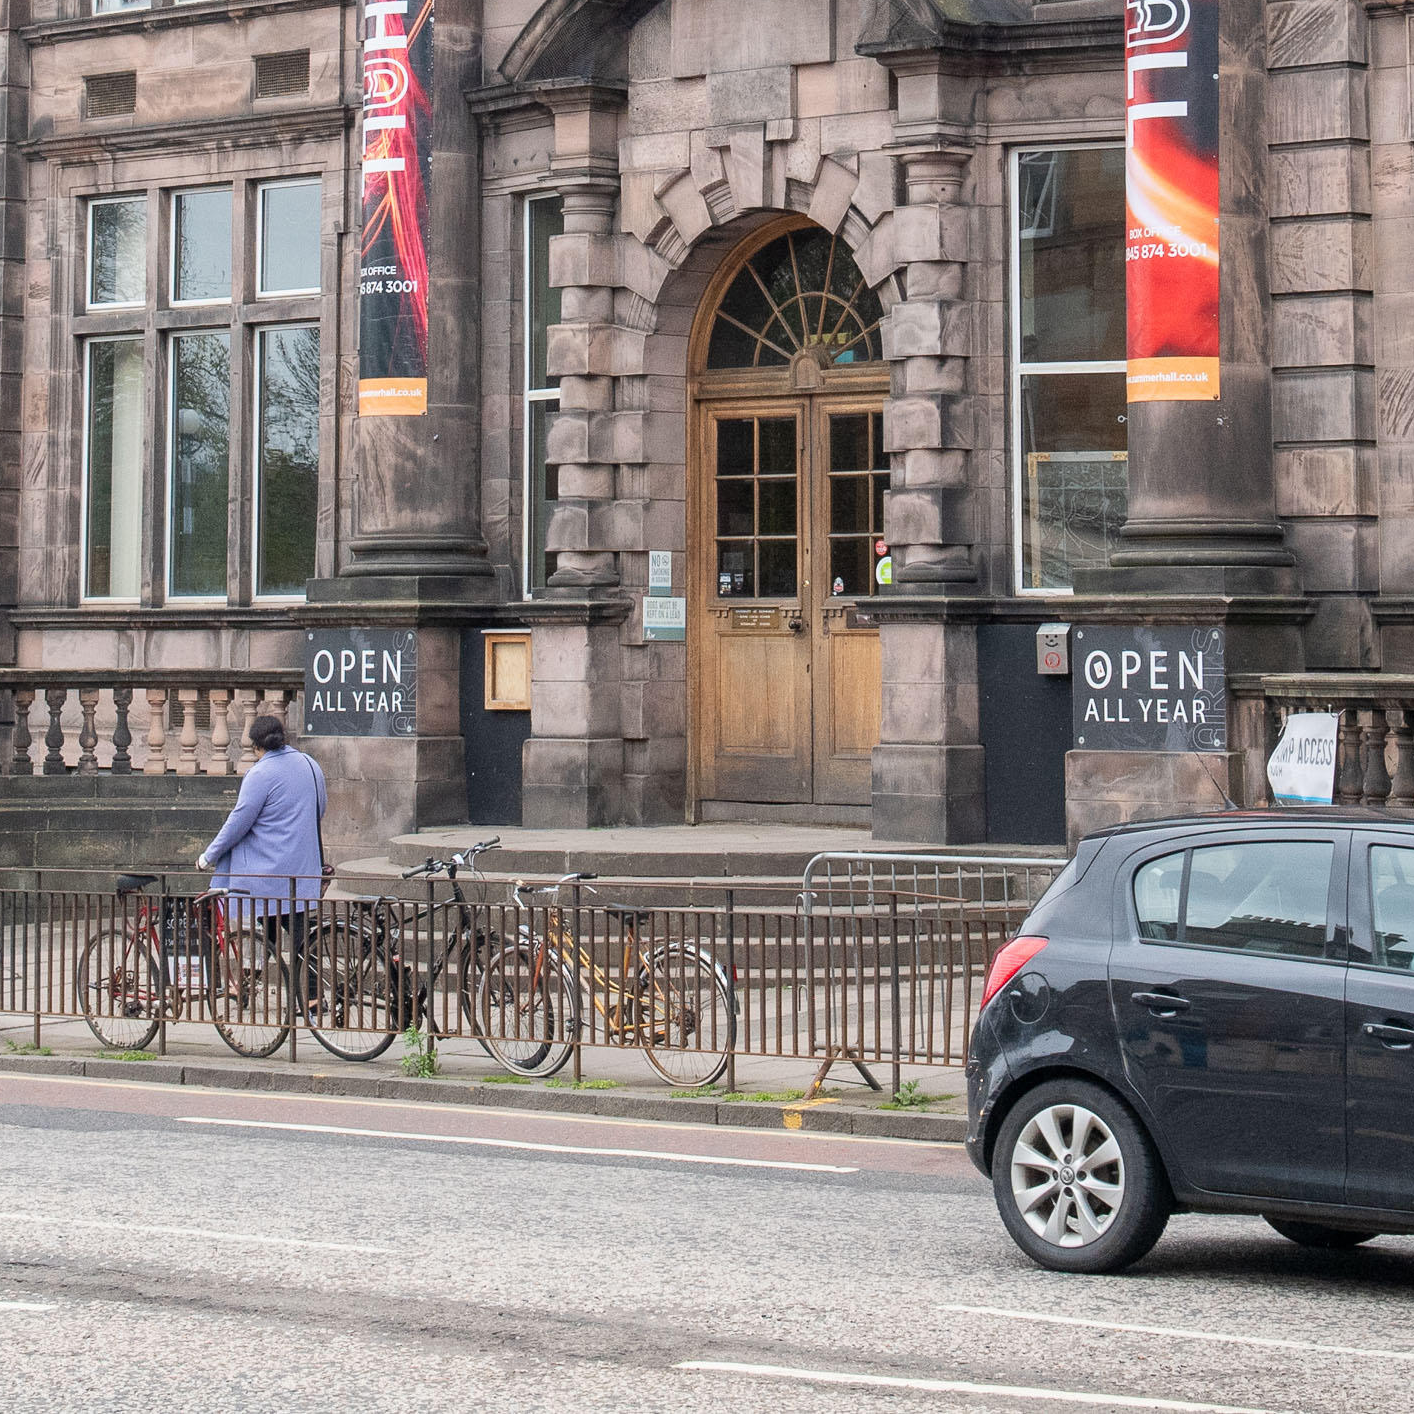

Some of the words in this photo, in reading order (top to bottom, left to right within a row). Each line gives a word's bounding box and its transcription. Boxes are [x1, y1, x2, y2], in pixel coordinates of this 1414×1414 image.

[1130, 228, 1142, 240] BOX
[1141, 244, 1164, 258] 874
[1168, 243, 1206, 257] 3001
[368, 266, 397, 276] OFFICE
[366, 281, 383, 294] 874
[386, 280, 418, 293] 3001
[652, 554, 660, 567] NO
[647, 610, 657, 618] KEPT
[670, 610, 681, 619] LEAD
[313, 650, 401, 683] OPEN
[1085, 650, 1204, 690] OPEN
[312, 691, 346, 711] ALL
[352, 691, 402, 712] YEAR
[1085, 699, 1130, 722] ALL
[1138, 699, 1206, 723] YEAR
[1297, 737, 1333, 765] ACCESS
